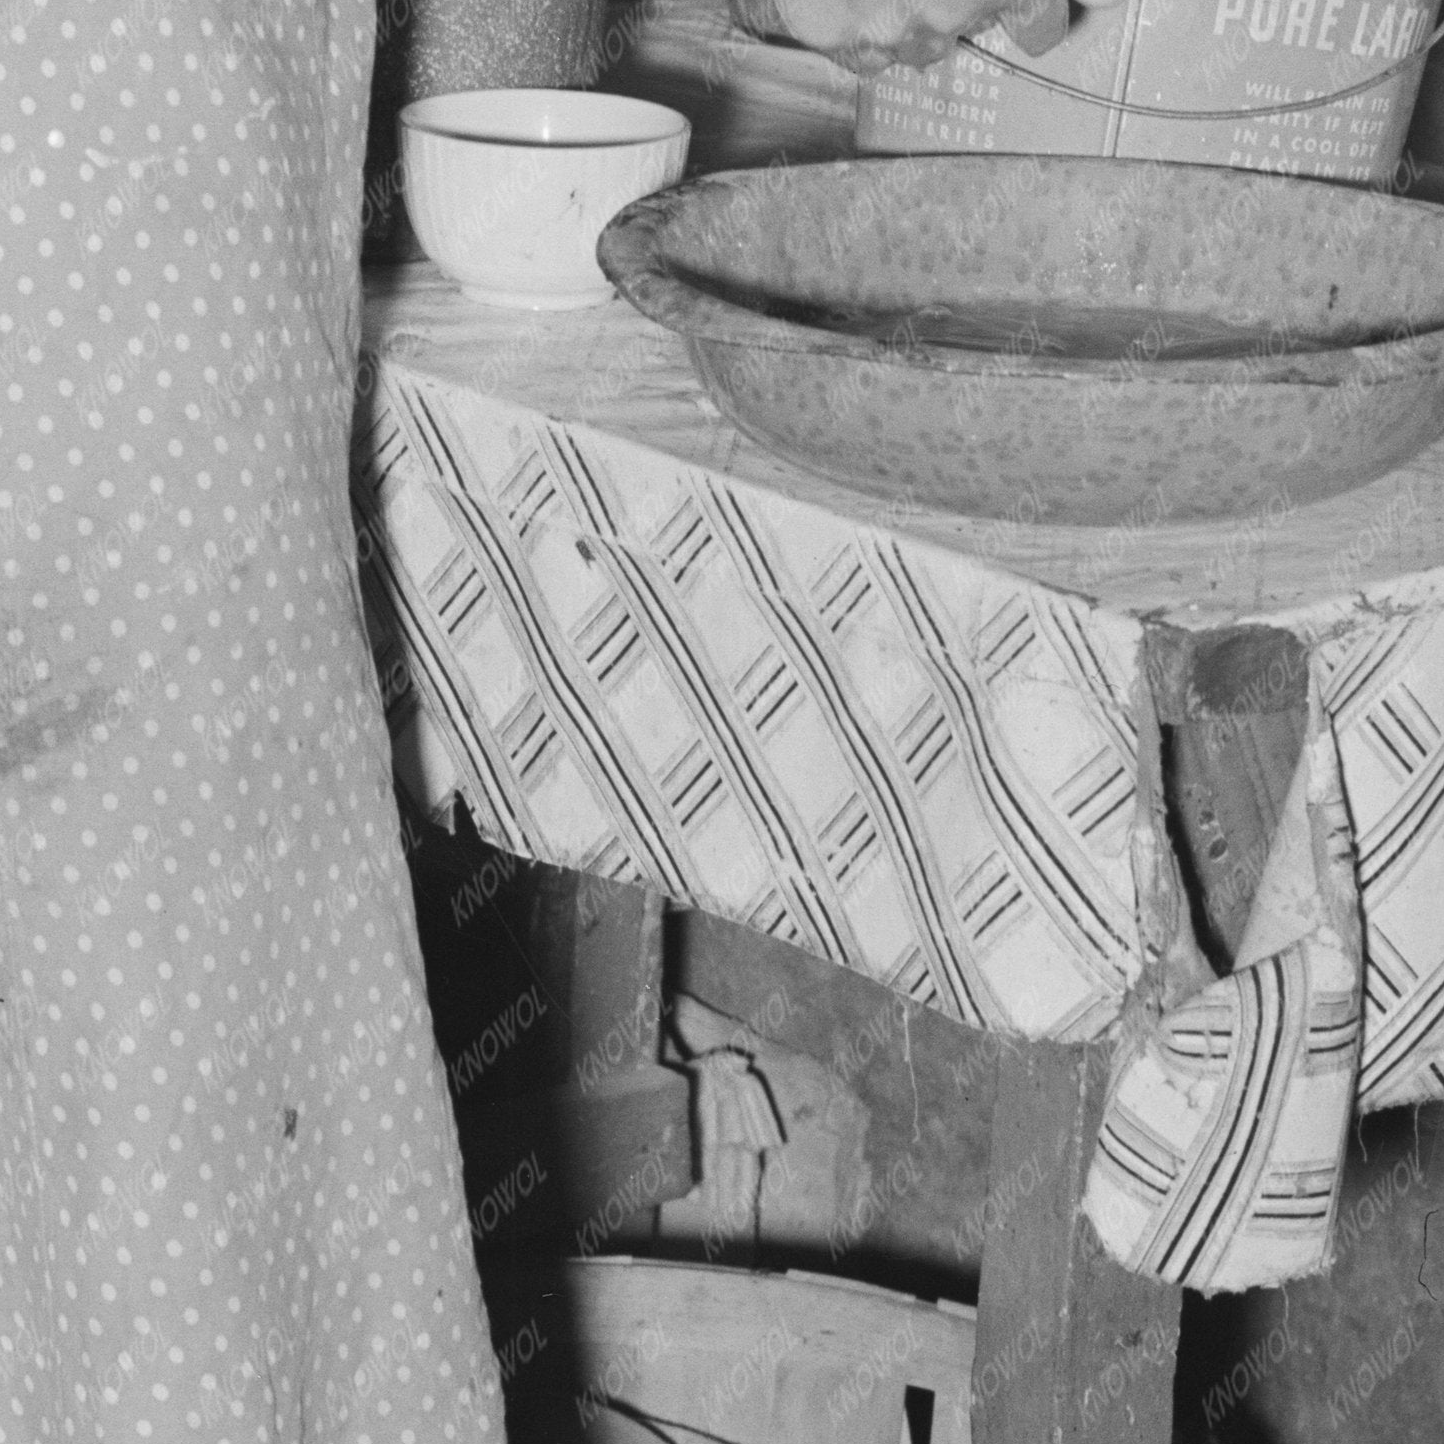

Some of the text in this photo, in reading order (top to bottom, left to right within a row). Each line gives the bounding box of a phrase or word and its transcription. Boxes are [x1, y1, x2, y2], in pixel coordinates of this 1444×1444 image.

[952, 77, 999, 102] OUR
[1244, 80, 1293, 103] WILL
[875, 82, 997, 125] CLEAN MODERN
[1324, 115, 1342, 132] IF
[1348, 118, 1385, 136] KEPT
[1232, 127, 1379, 159] IN A COOL DRY
